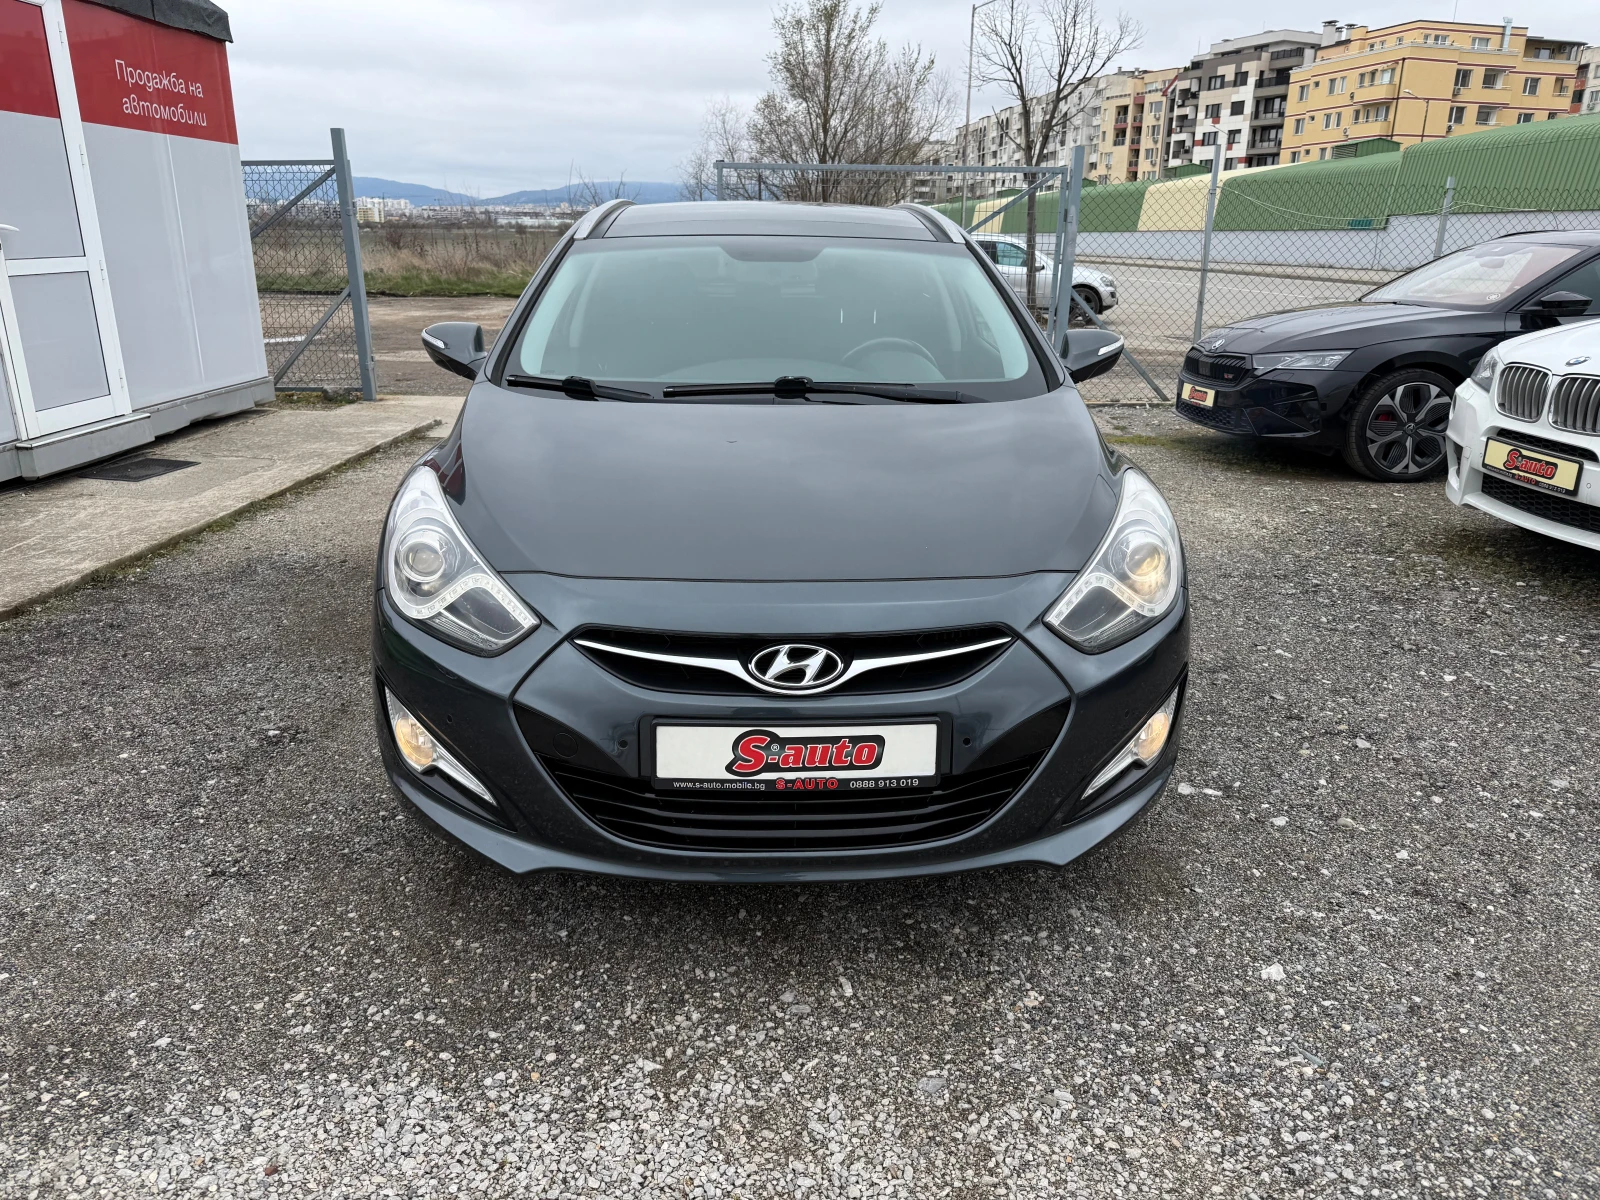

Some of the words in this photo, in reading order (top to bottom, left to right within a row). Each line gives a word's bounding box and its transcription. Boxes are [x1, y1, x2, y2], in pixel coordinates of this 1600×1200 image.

[115, 59, 186, 94] Продажба
[188, 81, 204, 98] на
[122, 94, 207, 126] автомобили
[673, 781, 766, 791] www.s-auto.mobile.bg
[775, 779, 839, 790] S-AUTO
[849, 780, 875, 789] 0888
[878, 779, 897, 788] 913
[899, 778, 919, 787] 019
